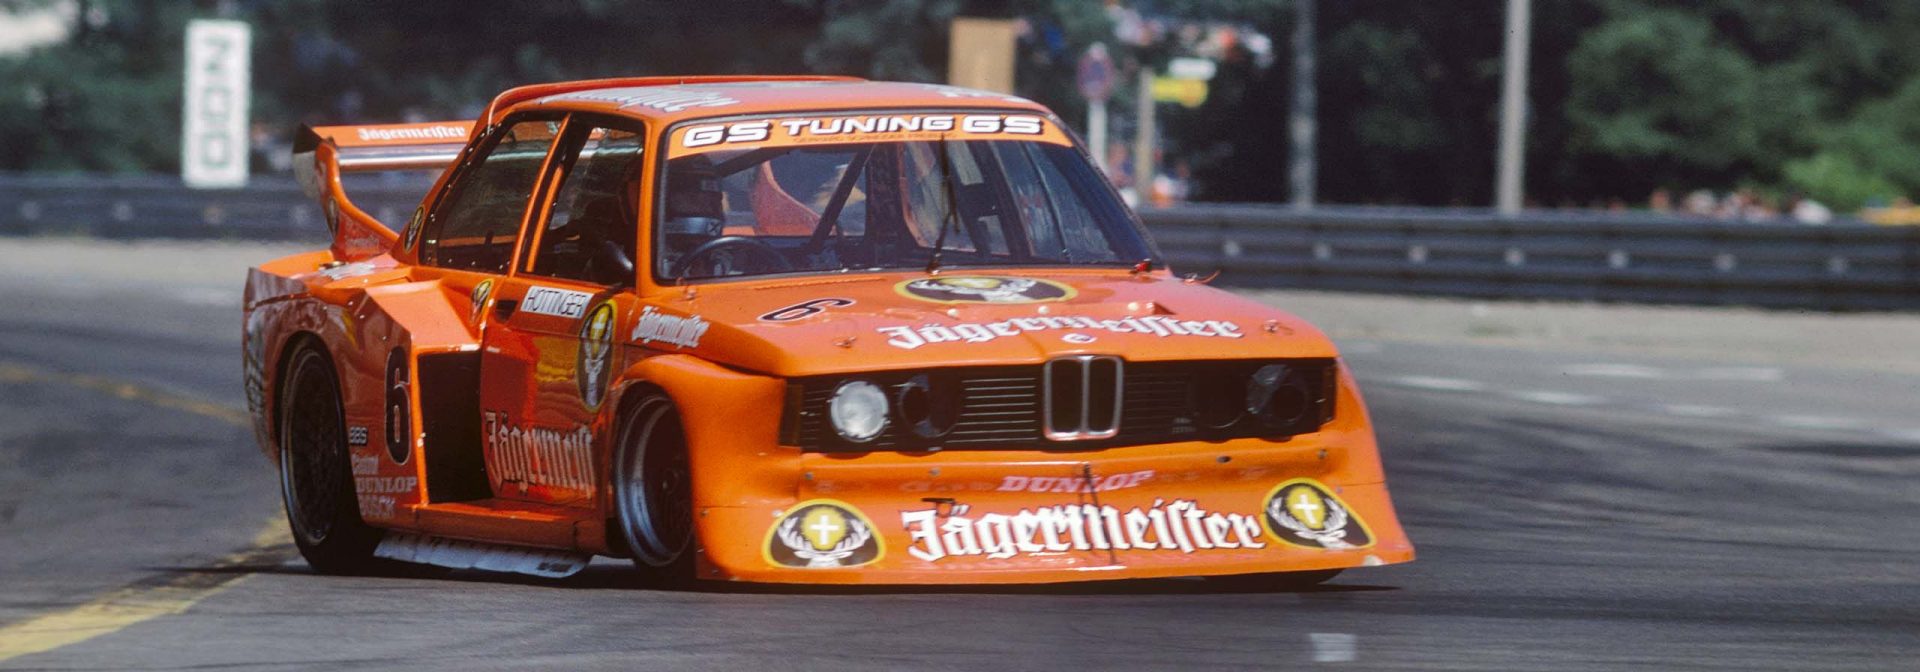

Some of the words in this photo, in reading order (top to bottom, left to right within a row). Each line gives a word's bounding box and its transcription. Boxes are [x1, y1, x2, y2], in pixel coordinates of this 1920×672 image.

[682, 119, 774, 148] GS
[781, 115, 955, 136] TUNING
[961, 115, 1043, 135] GS
[757, 298, 857, 321] 6
[385, 344, 411, 466] 6
[355, 476, 417, 494] DUNLOP
[996, 470, 1155, 493] DUNLOP
[900, 499, 1265, 562] Jägermeister
